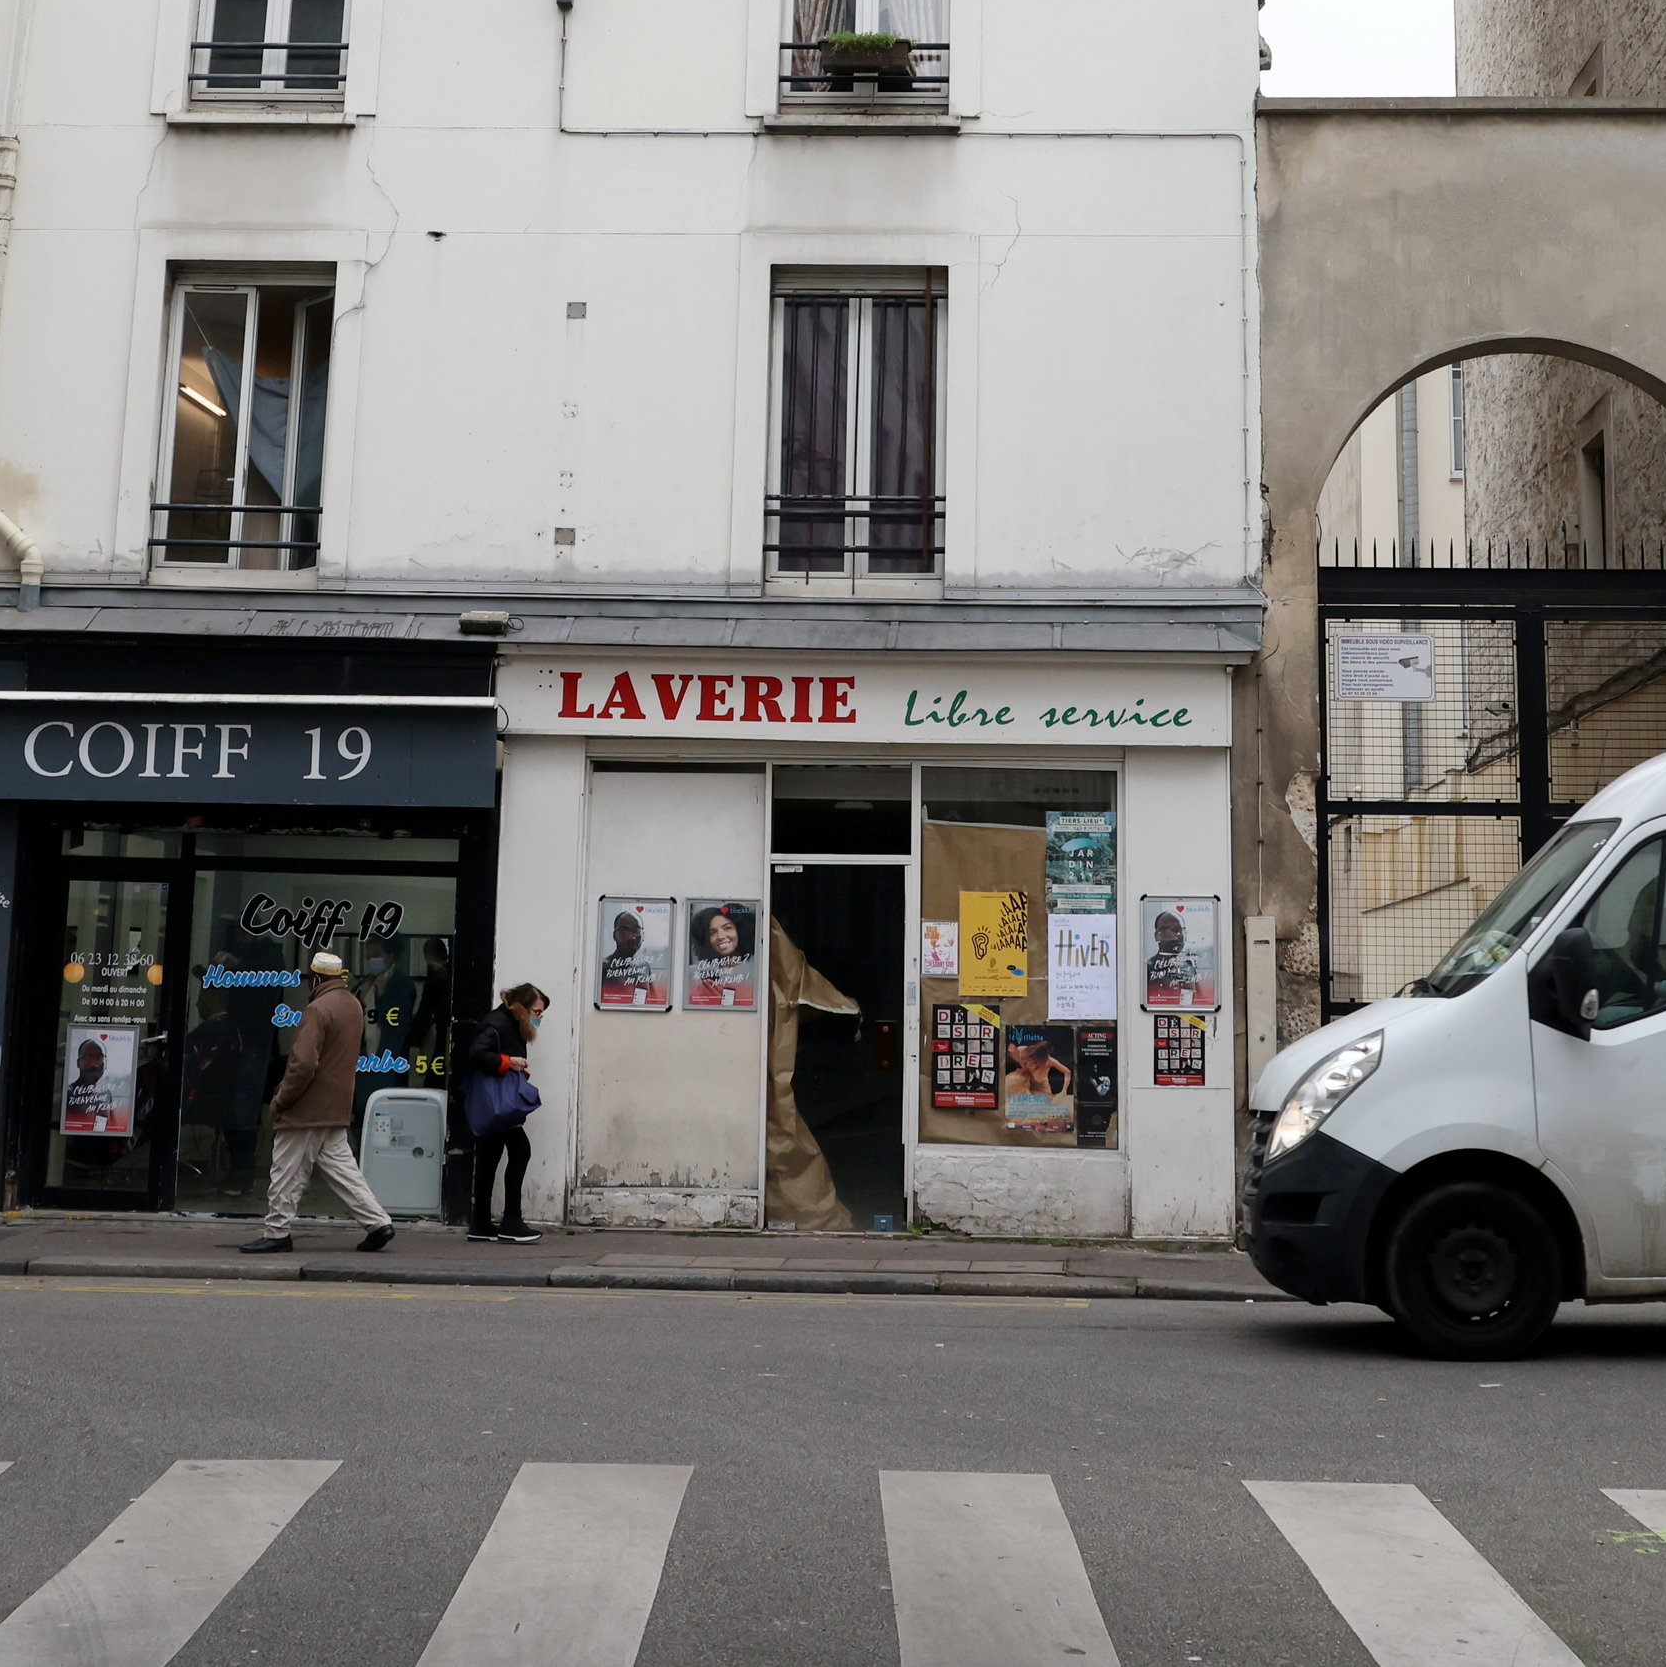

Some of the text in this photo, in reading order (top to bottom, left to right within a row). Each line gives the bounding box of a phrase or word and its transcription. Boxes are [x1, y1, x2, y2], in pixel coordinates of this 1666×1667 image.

[557, 670, 1193, 729] LAVERIE Libre service
[24, 721, 372, 781] COIFF 19
[1069, 848, 1094, 858] JAR
[1068, 860, 1094, 869] DIN
[240, 892, 404, 950] Coiff 19
[70, 952, 154, 966] 06 23 12 38 60
[101, 967, 128, 977] OUVERT
[202, 964, 301, 988] Hommes
[81, 984, 90, 992] Du
[91, 985, 108, 993] mardi
[118, 985, 147, 994] dimanche
[105, 998, 114, 1006] 00
[120, 999, 129, 1007] 20
[129, 999, 135, 1007] H
[136, 999, 144, 1007] 00
[73, 1014, 87, 1022] Avec
[111, 1015, 147, 1023] rendez-vous
[386, 1007, 400, 1027] €
[355, 1049, 410, 1073] arbe
